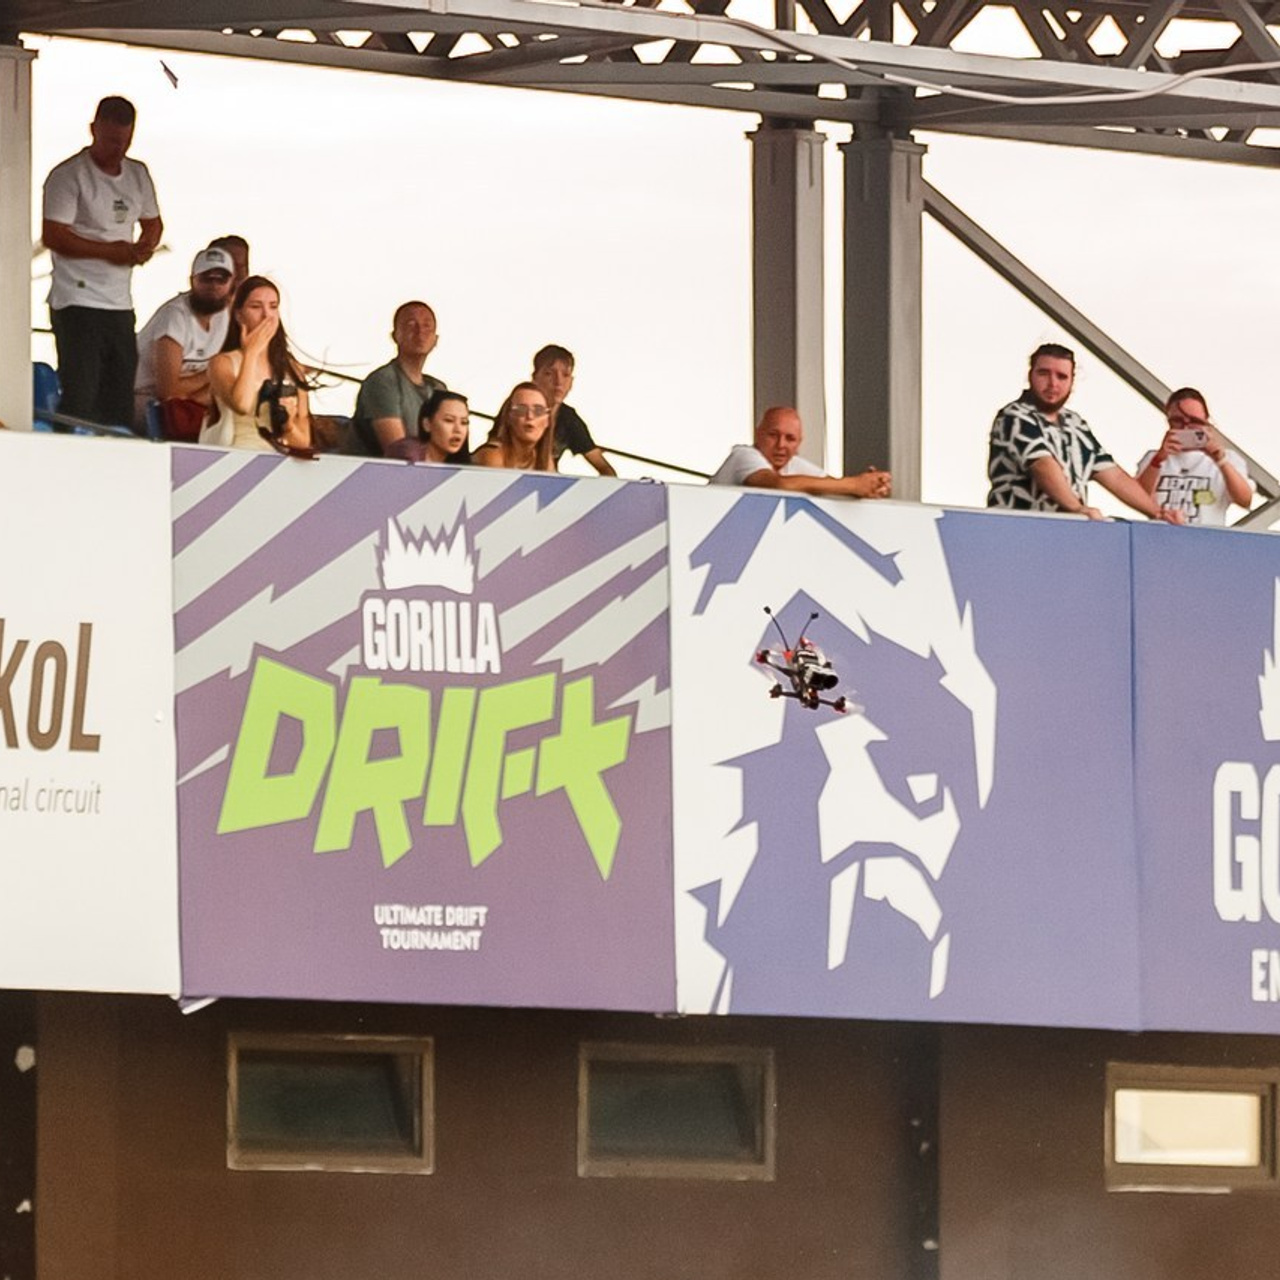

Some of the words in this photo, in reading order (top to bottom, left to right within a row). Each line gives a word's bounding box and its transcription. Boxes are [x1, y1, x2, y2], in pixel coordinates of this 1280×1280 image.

[363, 598, 501, 674] GORILLA
[217, 656, 632, 882] DRIFT
[35, 777, 102, 815] circuit
[374, 904, 443, 926] ULTIMATE
[445, 906, 488, 927] DRIFT
[380, 929, 481, 951] TOURNAMENT
